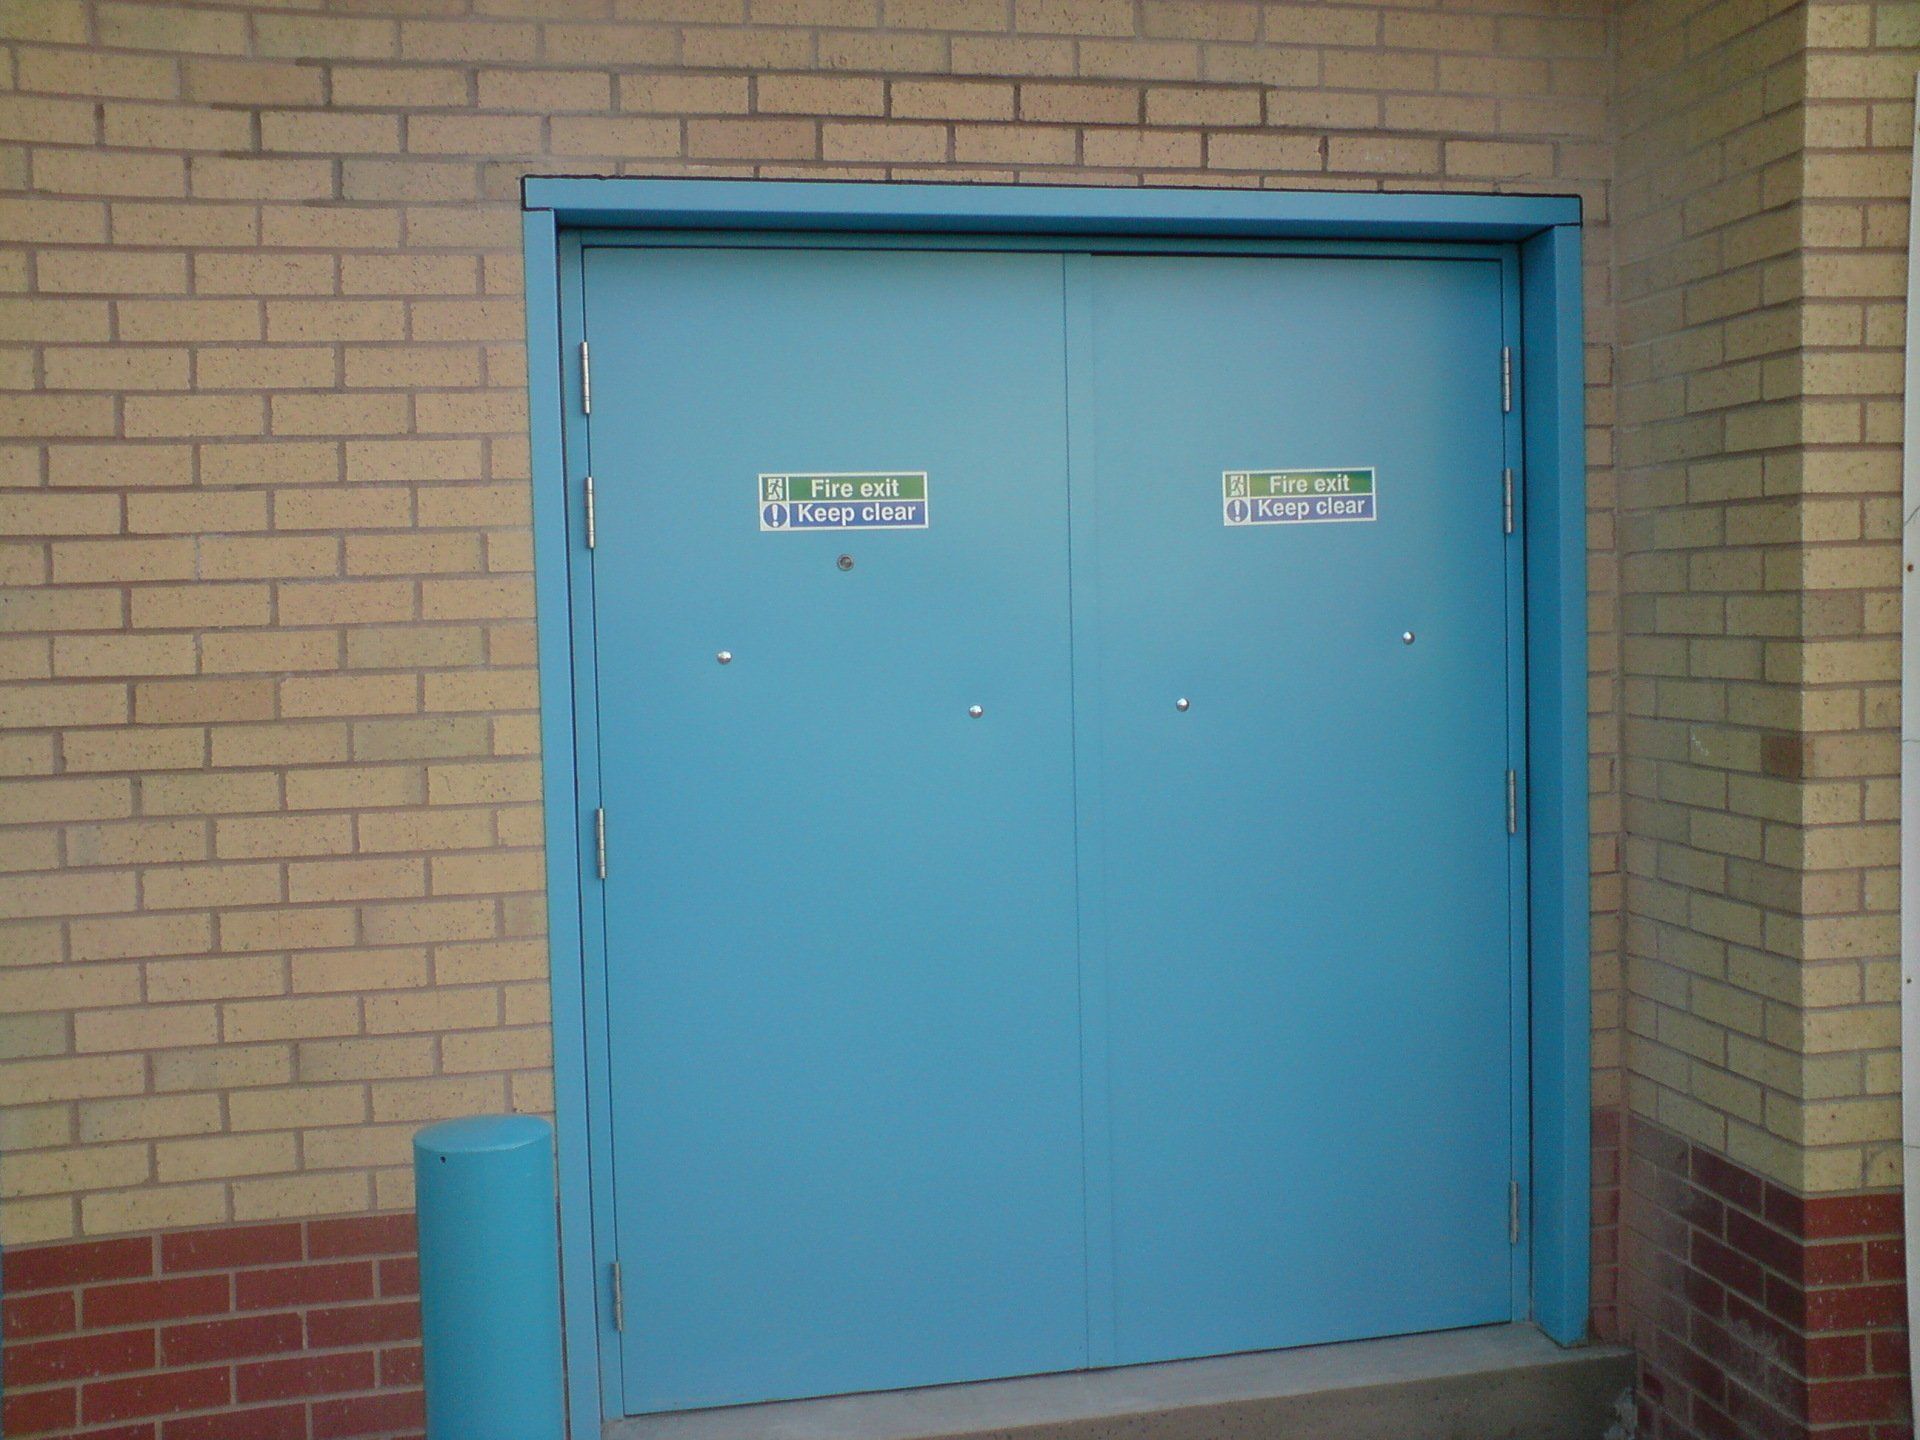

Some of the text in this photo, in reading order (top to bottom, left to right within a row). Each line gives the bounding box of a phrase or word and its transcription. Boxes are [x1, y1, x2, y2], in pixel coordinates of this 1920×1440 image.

[811, 478, 900, 498] Fire exit
[1269, 473, 1350, 494] Fire exit
[798, 502, 916, 526] Keep clear
[1258, 497, 1366, 520] Keep clear
